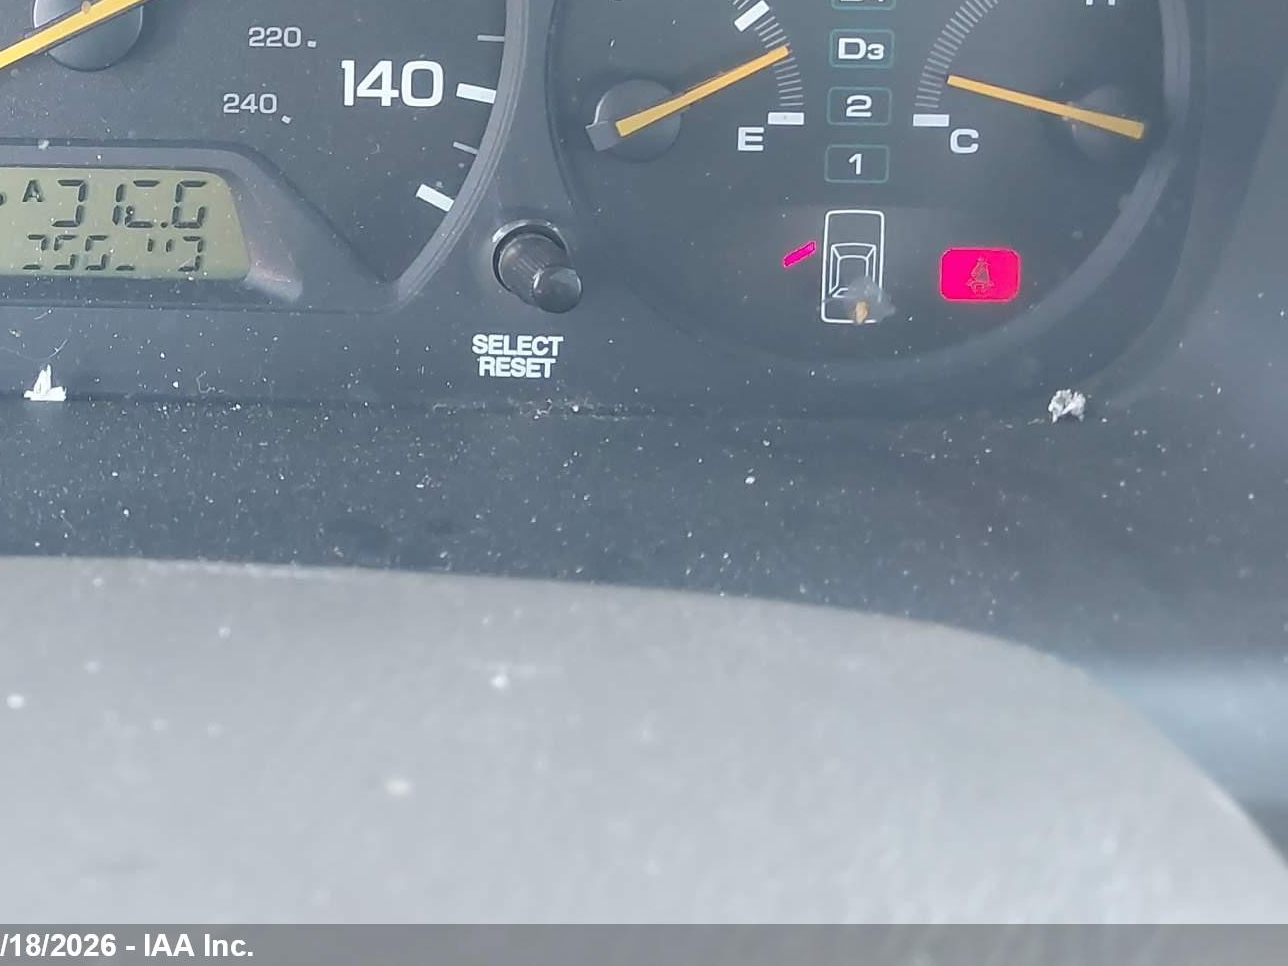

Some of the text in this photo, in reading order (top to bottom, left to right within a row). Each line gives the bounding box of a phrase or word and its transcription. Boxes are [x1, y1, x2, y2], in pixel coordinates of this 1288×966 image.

[248, 26, 302, 48] 220
[838, 37, 885, 60] D3
[341, 59, 444, 107] 140
[223, 93, 277, 114] 240
[845, 94, 873, 118] 2
[737, 126, 765, 152] E
[950, 128, 979, 154] C
[848, 153, 862, 175] 1
[22, 179, 43, 202] A
[471, 333, 564, 357] SELECT
[478, 355, 557, 378] RESET
